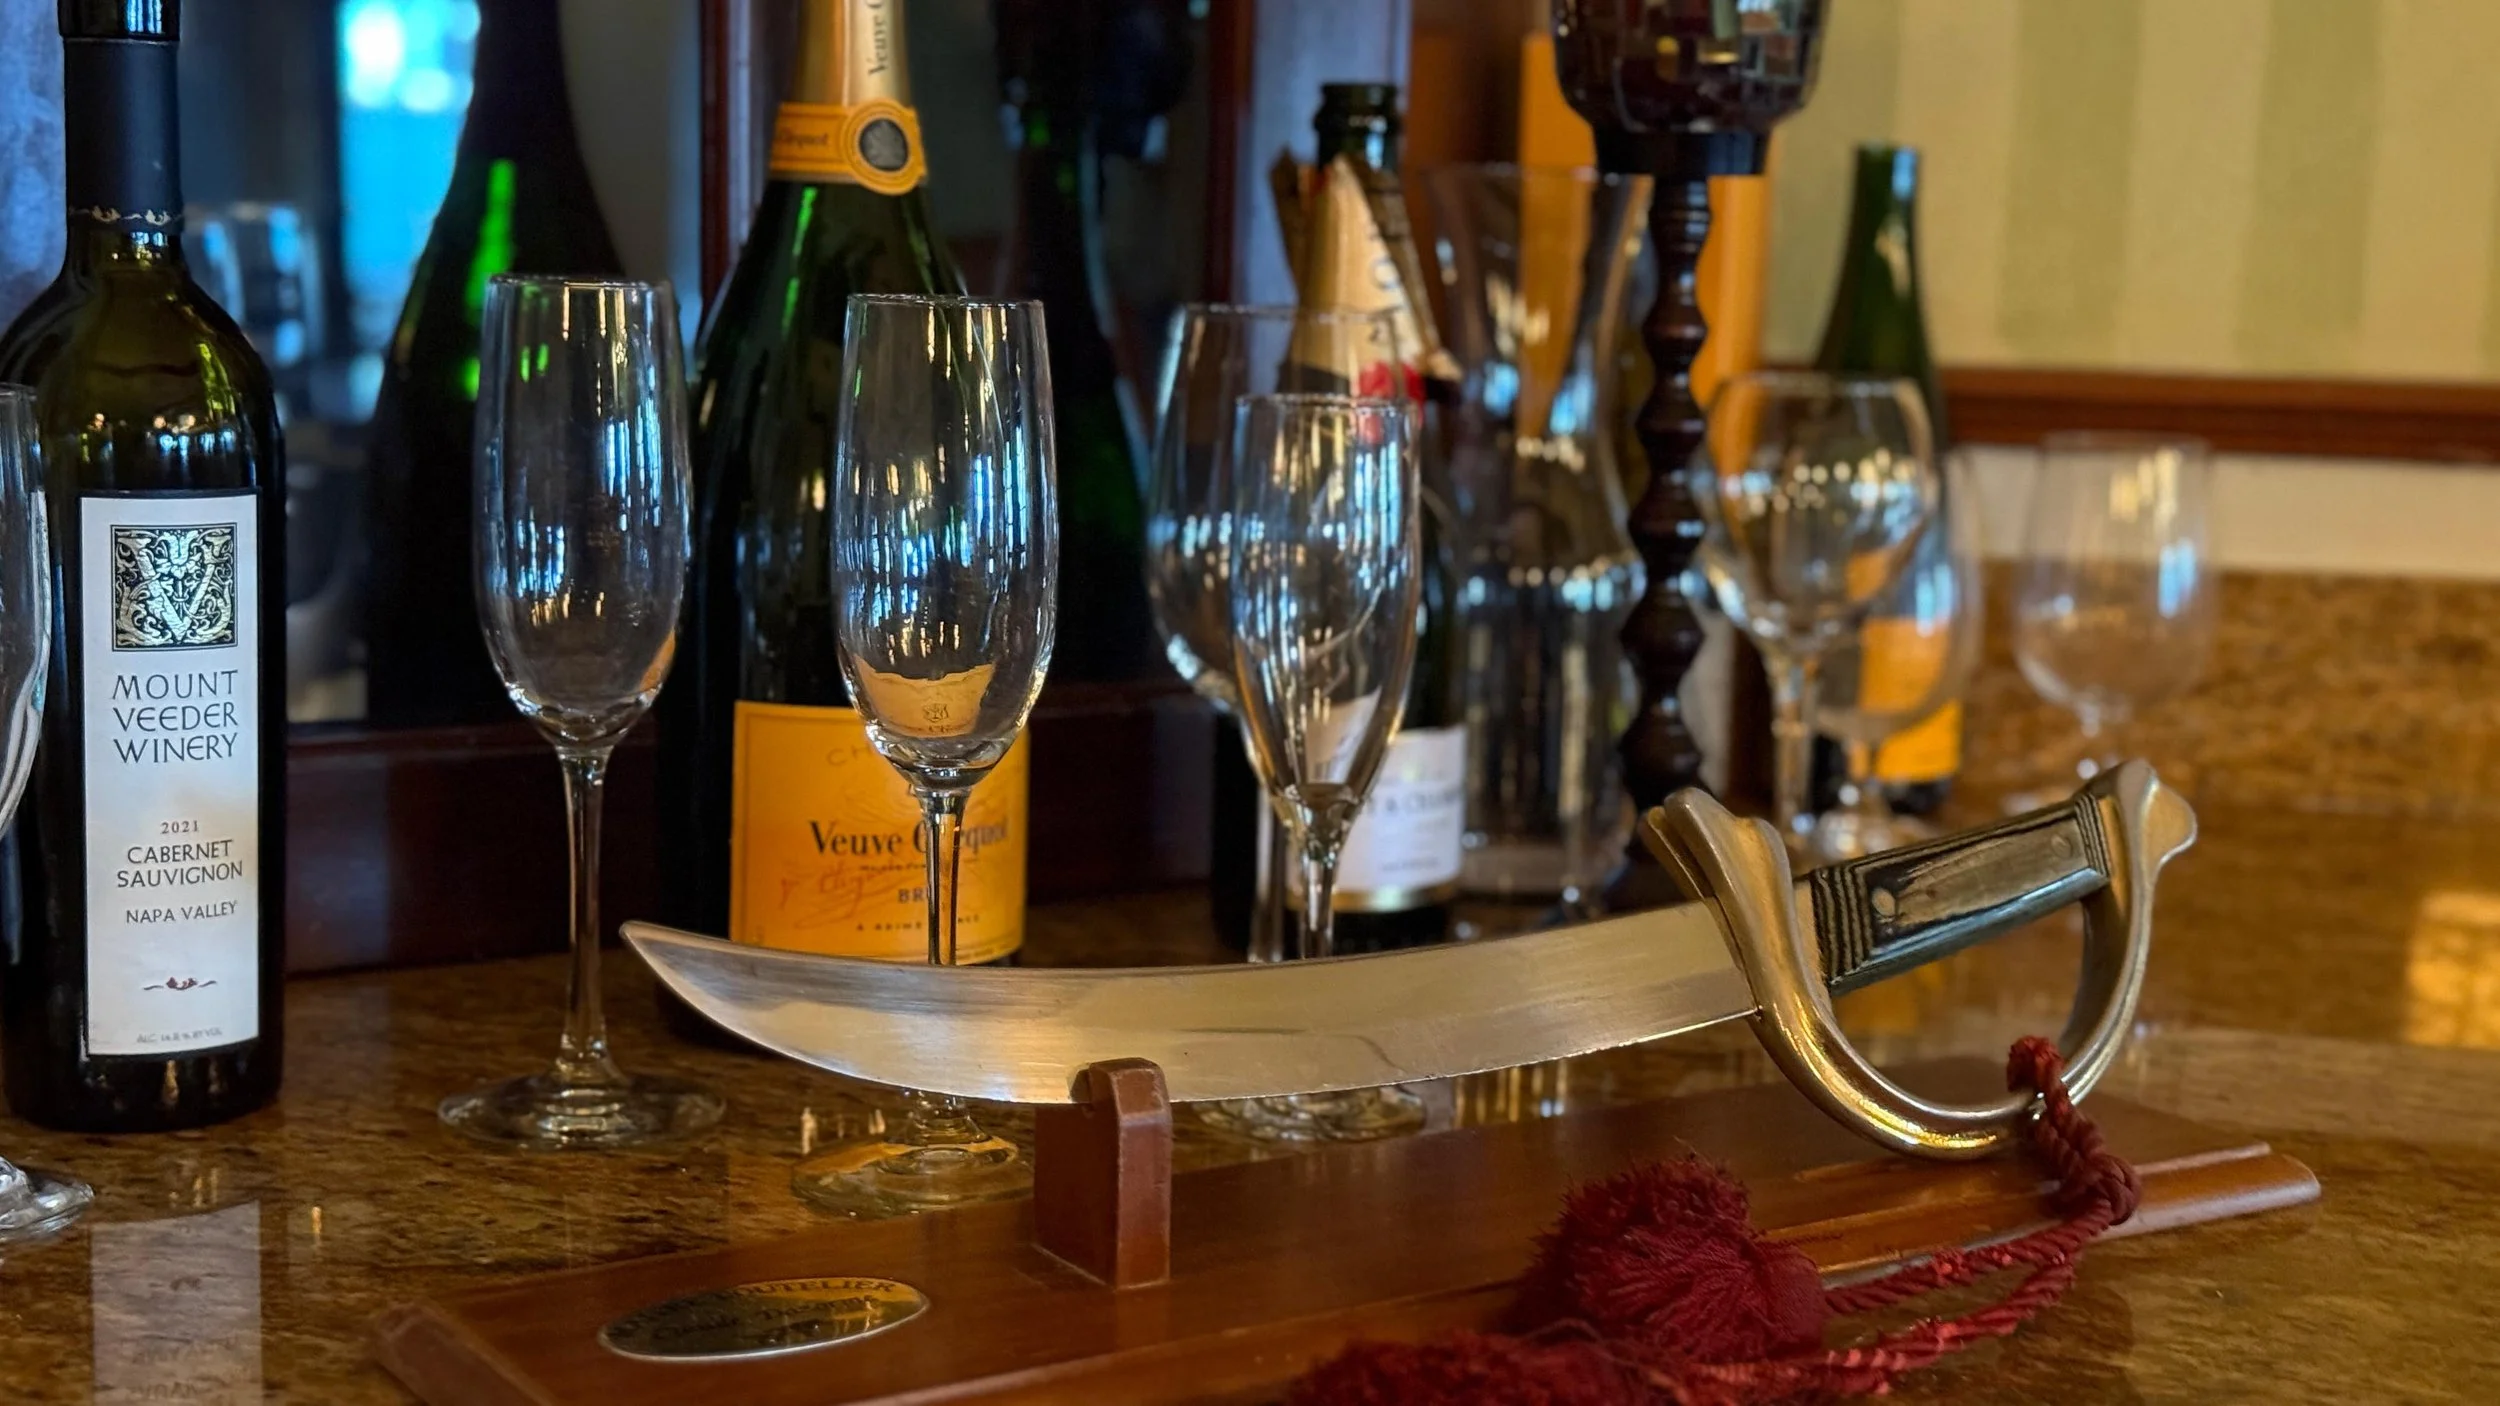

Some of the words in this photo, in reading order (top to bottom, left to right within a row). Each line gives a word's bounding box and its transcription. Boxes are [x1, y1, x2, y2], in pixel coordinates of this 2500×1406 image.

[112, 669, 239, 700] MOUNT
[112, 702, 239, 732] VEEDER
[113, 732, 238, 763] WINERY
[160, 820, 200, 834] 2021
[808, 820, 903, 856] Veuve
[127, 839, 233, 864] CABERNET
[117, 860, 243, 888] SAUVIGNON
[126, 908, 175, 924] NAPA
[180, 899, 237, 920] VALLEY
